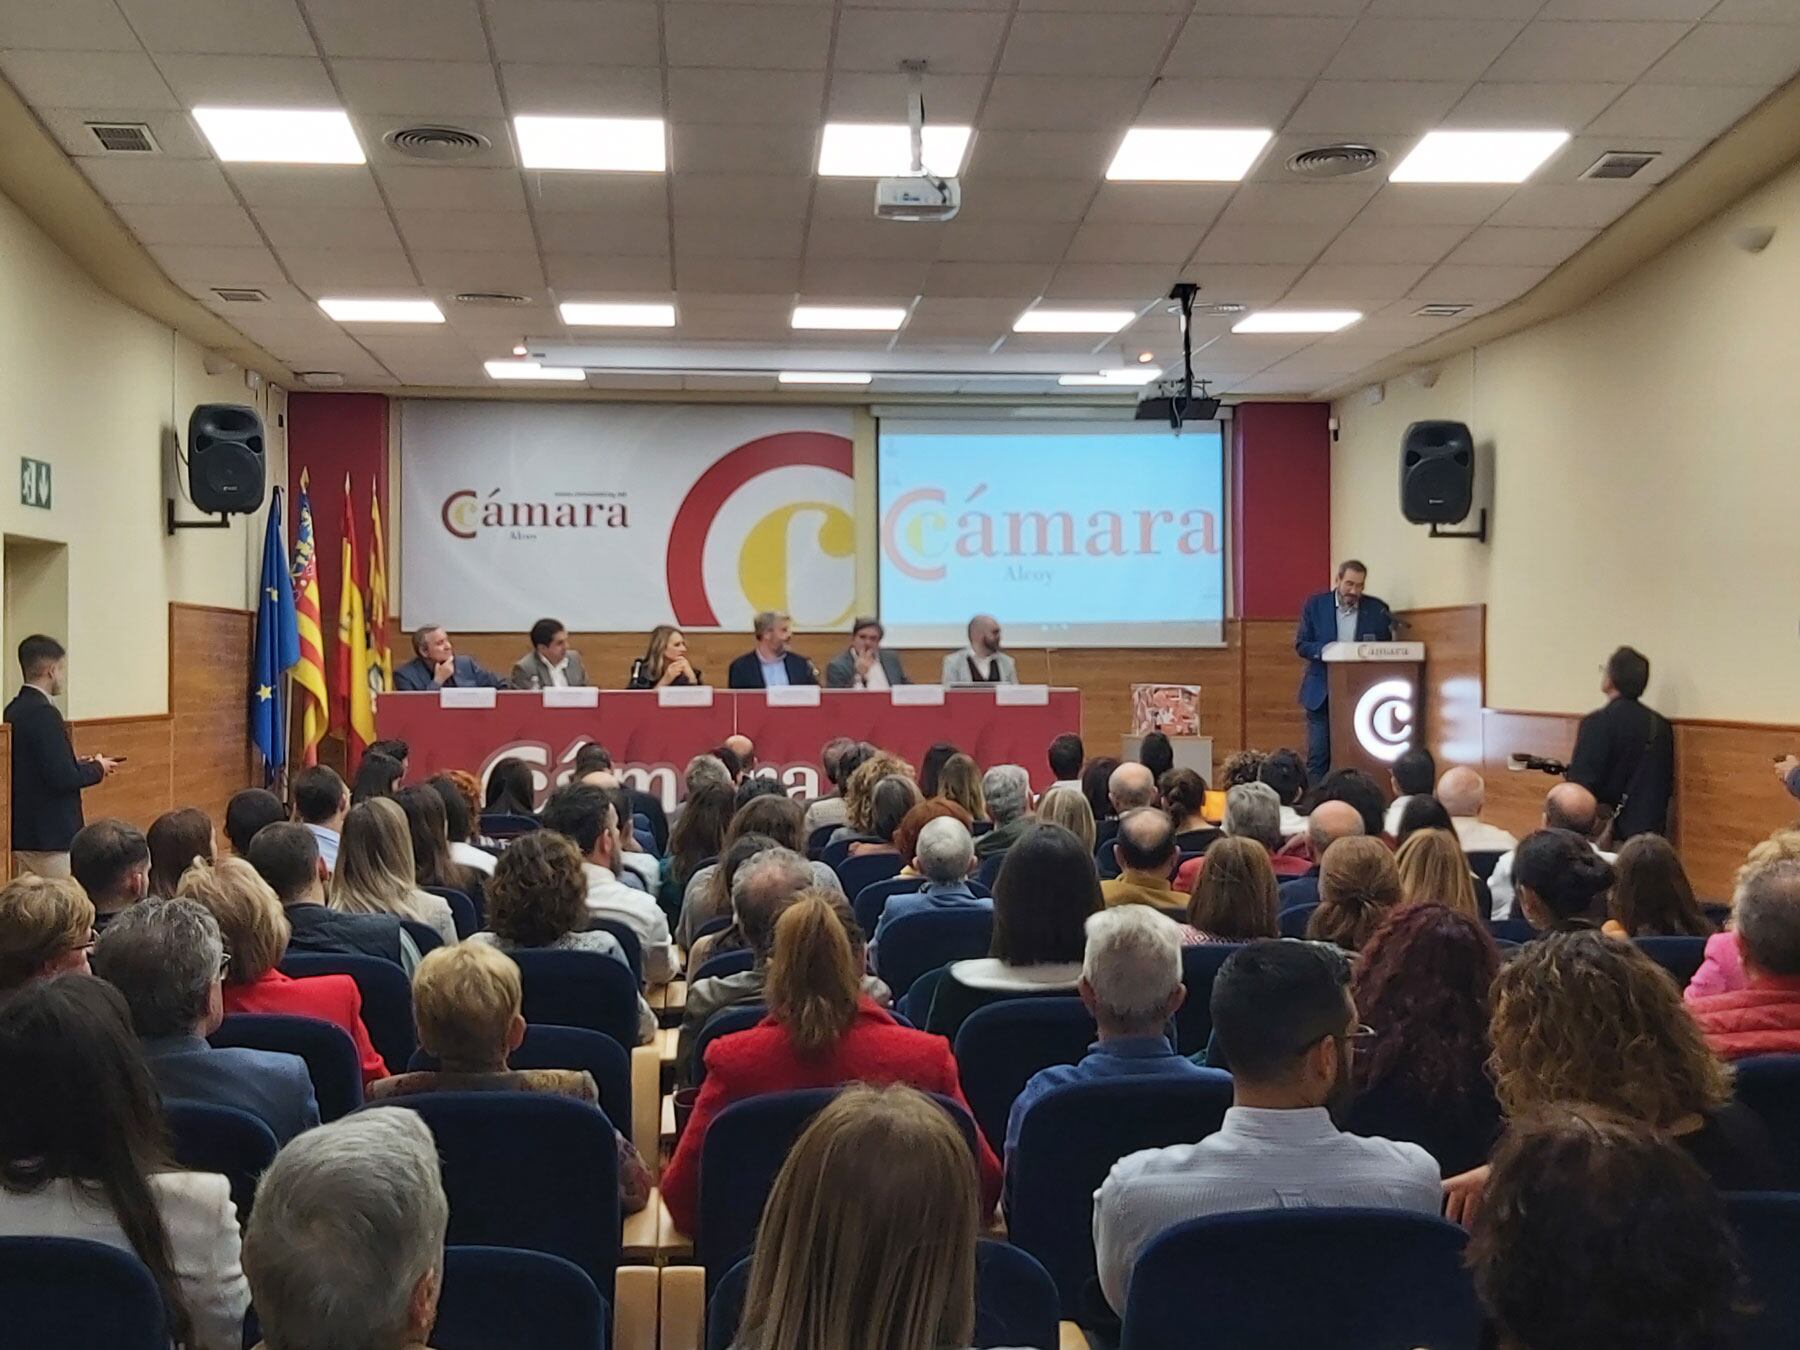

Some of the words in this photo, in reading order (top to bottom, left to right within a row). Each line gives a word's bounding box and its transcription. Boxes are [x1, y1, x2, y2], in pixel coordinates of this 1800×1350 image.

[442, 487, 630, 539] Cámara
[883, 483, 1221, 581] Cámara
[1005, 566, 1053, 585] Alcoy
